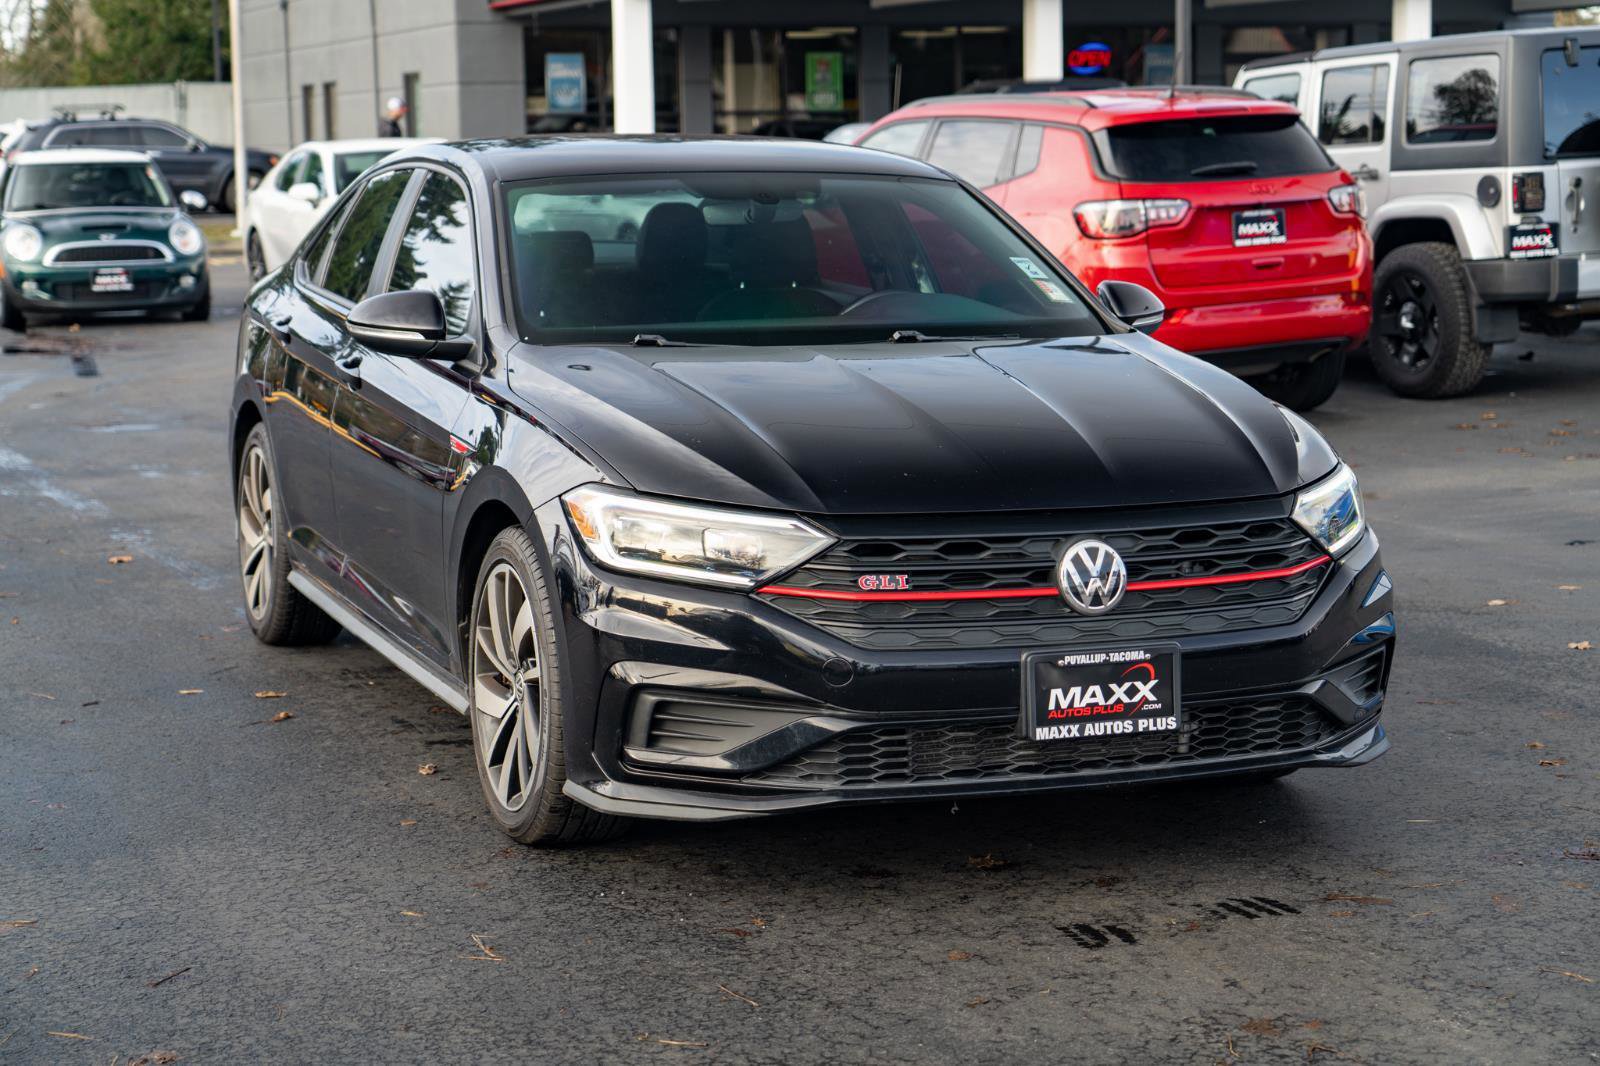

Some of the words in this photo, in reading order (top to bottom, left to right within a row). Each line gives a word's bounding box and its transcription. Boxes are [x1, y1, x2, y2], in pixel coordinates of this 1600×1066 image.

[1067, 50, 1111, 67] OPEN
[1238, 221, 1279, 235] MAXX
[1512, 234, 1553, 248] MAXX
[858, 574, 909, 590] GLI
[1048, 679, 1159, 710] MAXX
[1048, 706, 1091, 720] AUTOS
[1093, 703, 1125, 715] PLUS
[1035, 724, 1080, 741] MAXX
[1084, 720, 1134, 736] AUTOS
[1138, 716, 1177, 732] PLUS
